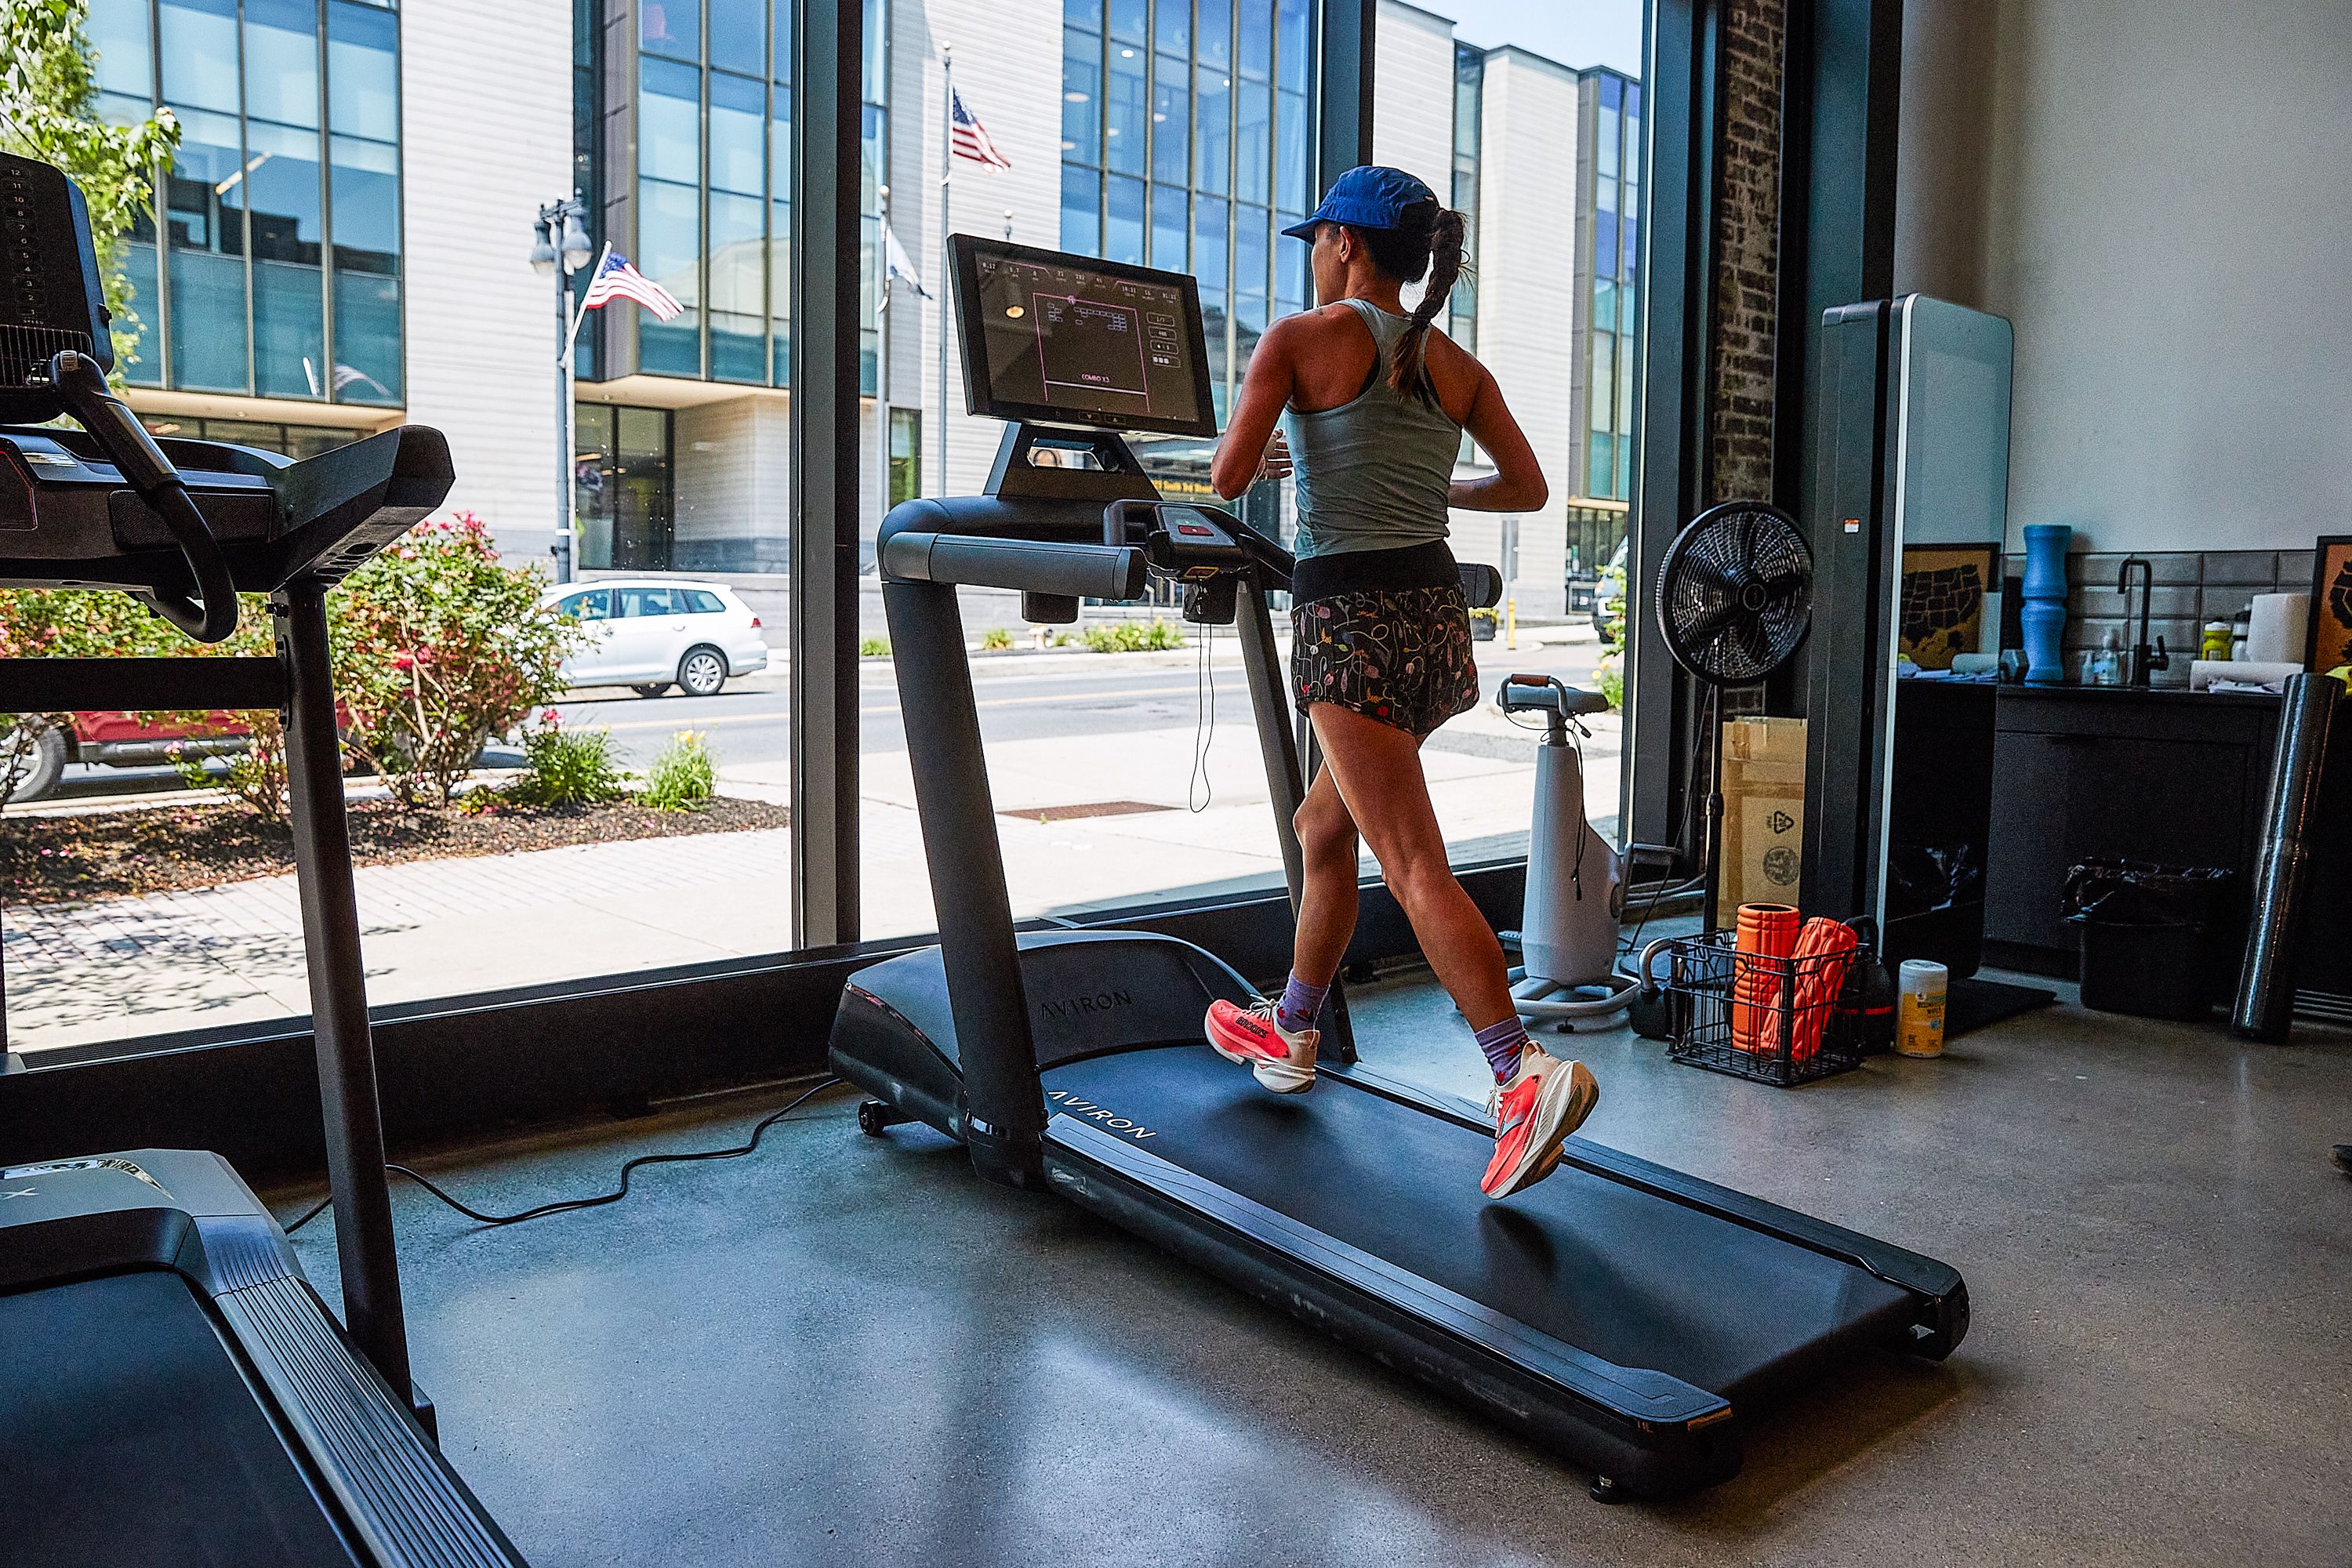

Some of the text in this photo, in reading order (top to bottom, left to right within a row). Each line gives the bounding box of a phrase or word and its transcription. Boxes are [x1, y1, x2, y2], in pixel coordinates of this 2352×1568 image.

[1040, 990, 1133, 1019] AVIRON
[1236, 1016, 1269, 1039] BROOKS
[1047, 1090, 1157, 1139] AVIRON
